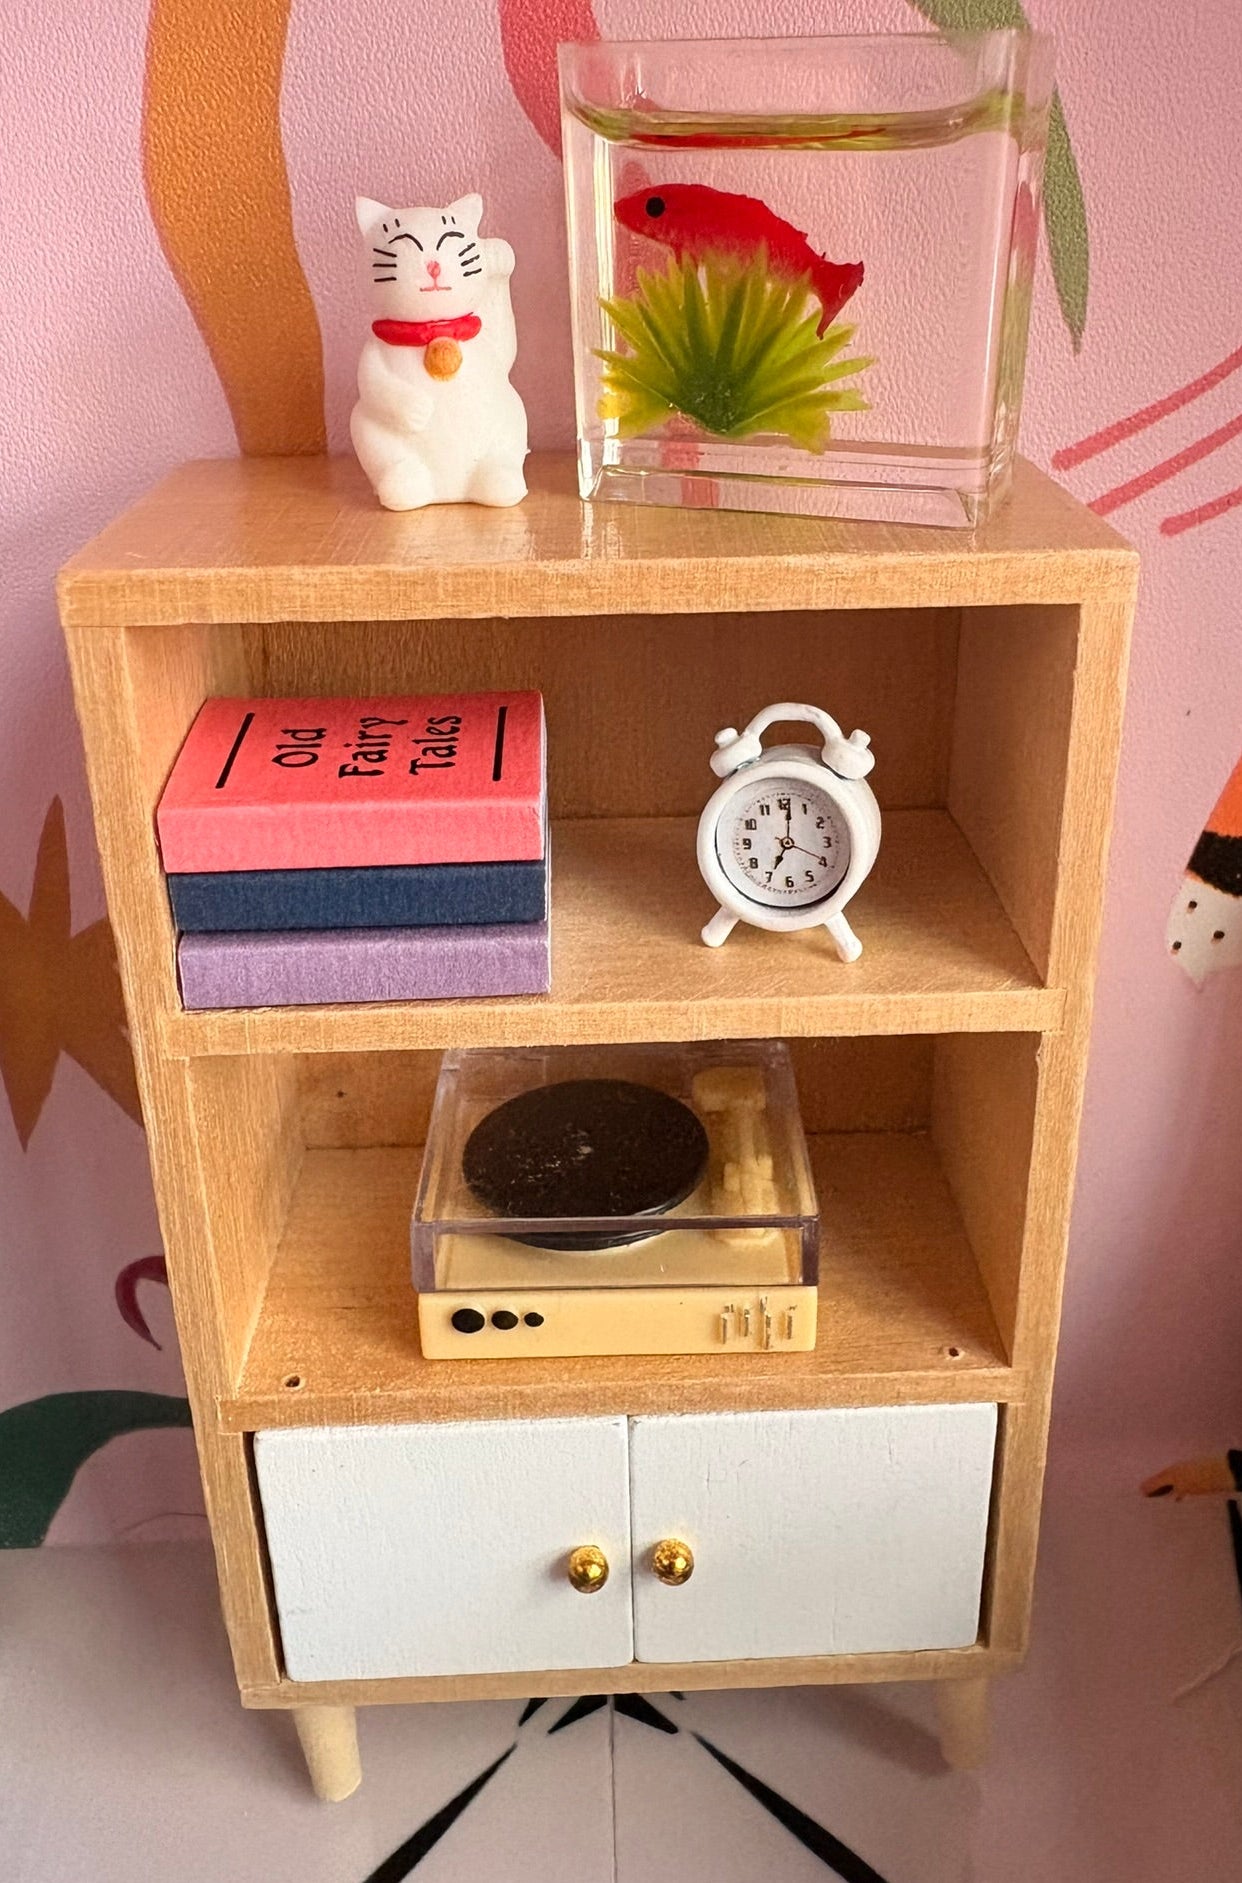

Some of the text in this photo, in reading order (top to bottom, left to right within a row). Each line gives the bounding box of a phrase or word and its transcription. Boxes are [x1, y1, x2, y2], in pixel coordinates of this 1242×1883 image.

[272, 727, 327, 767] Old
[338, 716, 408, 778] Fairy
[409, 714, 462, 776] Tales
[759, 804, 770, 816] 11
[802, 804, 808, 815] 1
[745, 819, 757, 831] 10
[816, 817, 825, 829] 2
[742, 838, 751, 849] 9
[823, 837, 832, 848] 3
[749, 857, 758, 869] 8
[819, 856, 828, 867] 4
[764, 871, 773, 883] 7
[785, 875, 794, 887] 6
[805, 871, 814, 883] 5
